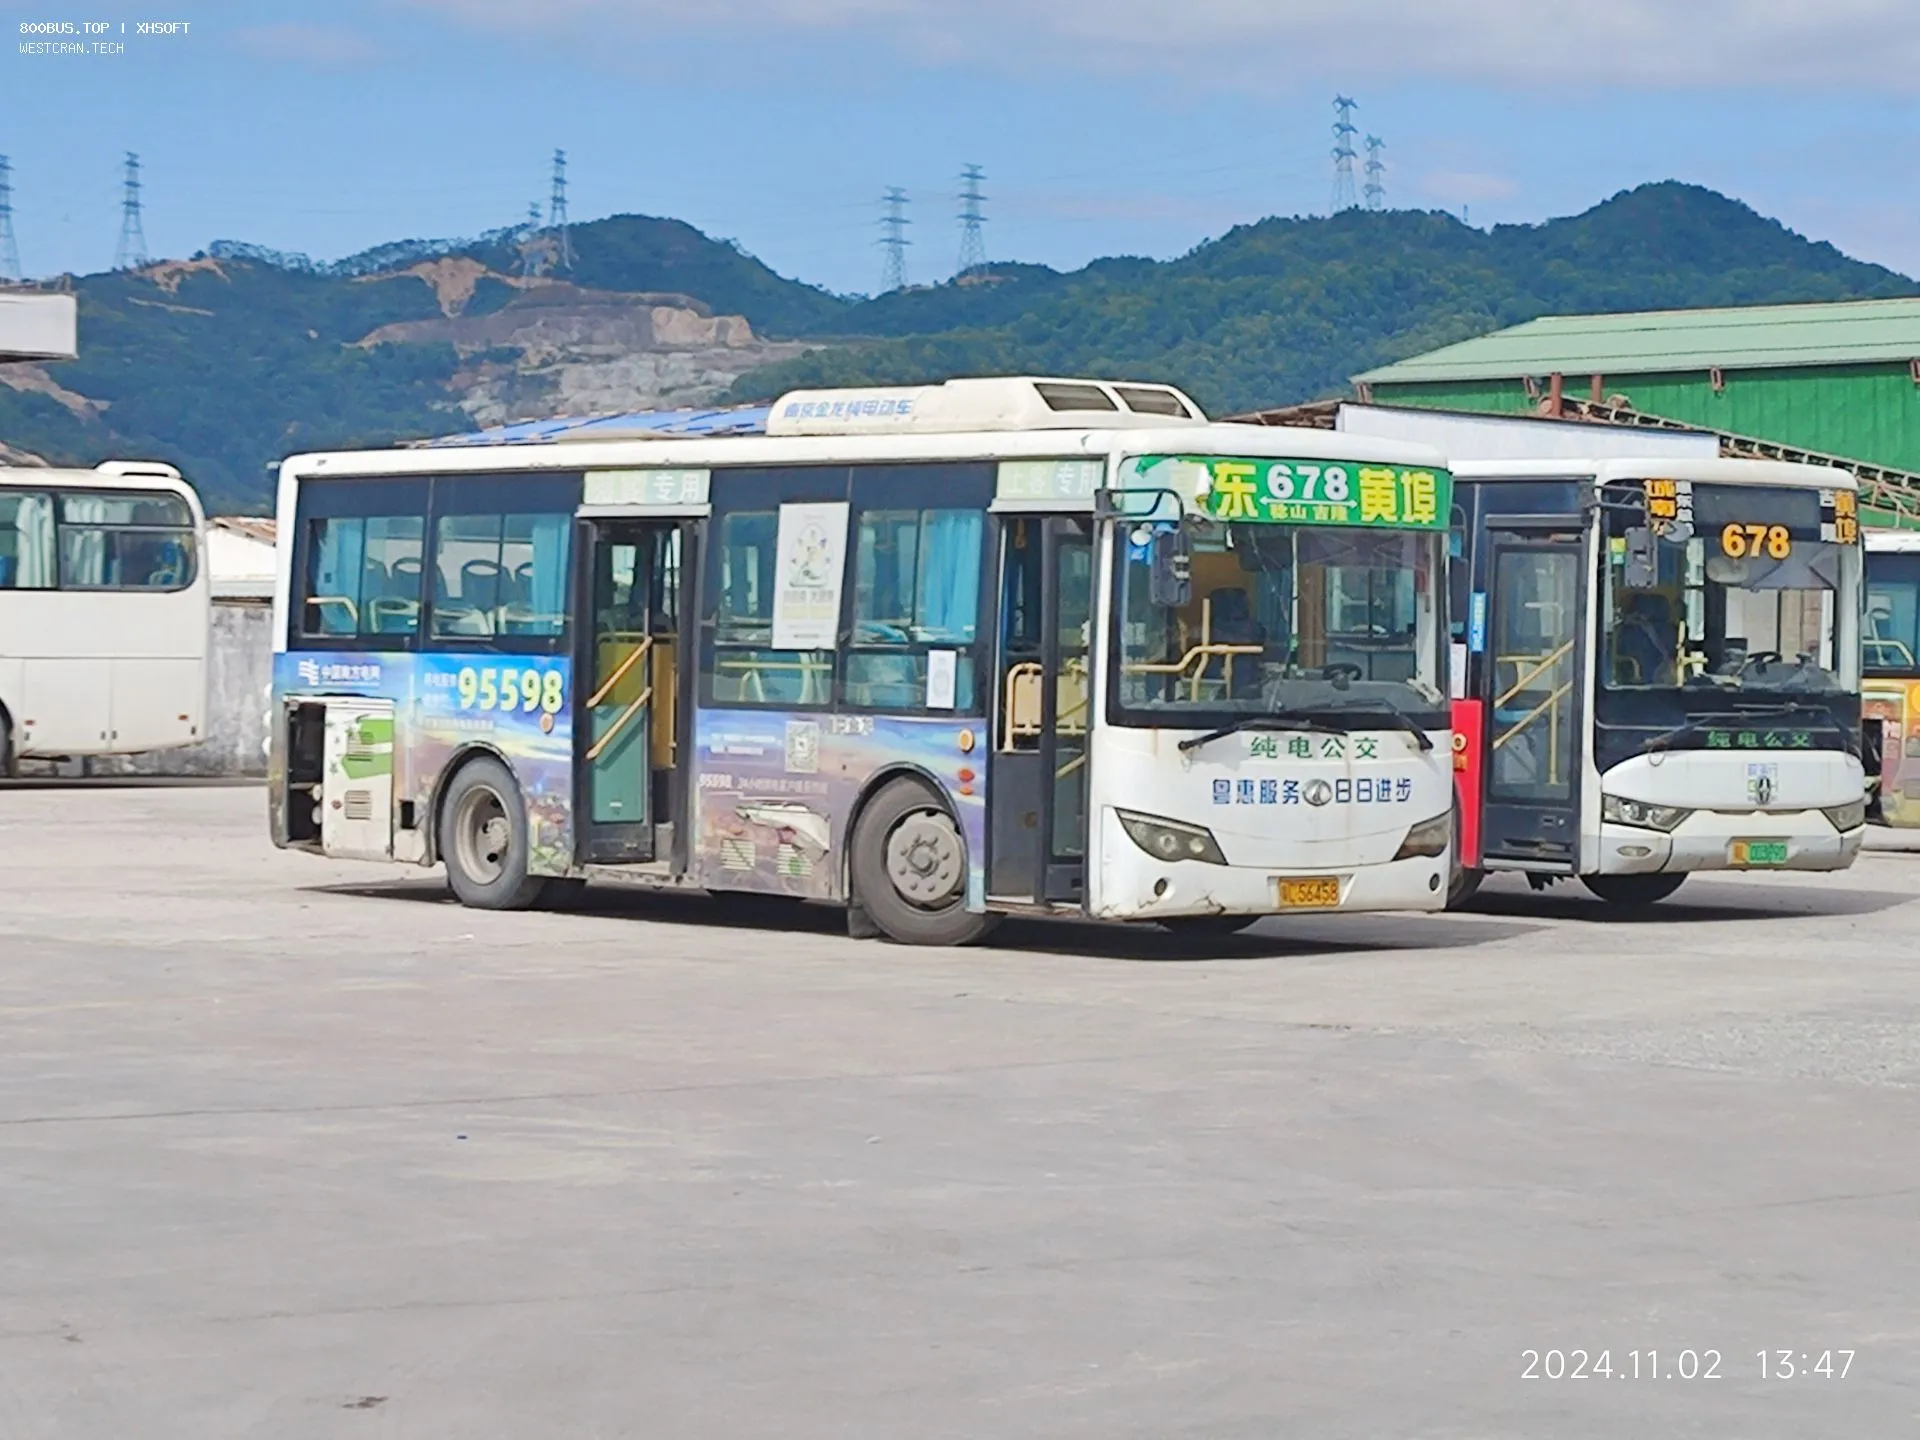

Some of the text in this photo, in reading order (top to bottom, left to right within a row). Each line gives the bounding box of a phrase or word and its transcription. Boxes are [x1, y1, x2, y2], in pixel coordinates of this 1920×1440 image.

[1266, 463, 1350, 501] 678
[1359, 467, 1437, 523] 黄埠
[1721, 523, 1791, 560] 678
[458, 665, 563, 713] 95598
[1250, 735, 1380, 759] 纯电公交
[1706, 731, 1813, 748] 纯电公交
[1212, 777, 1413, 804] 粤惠服务 日日进步
